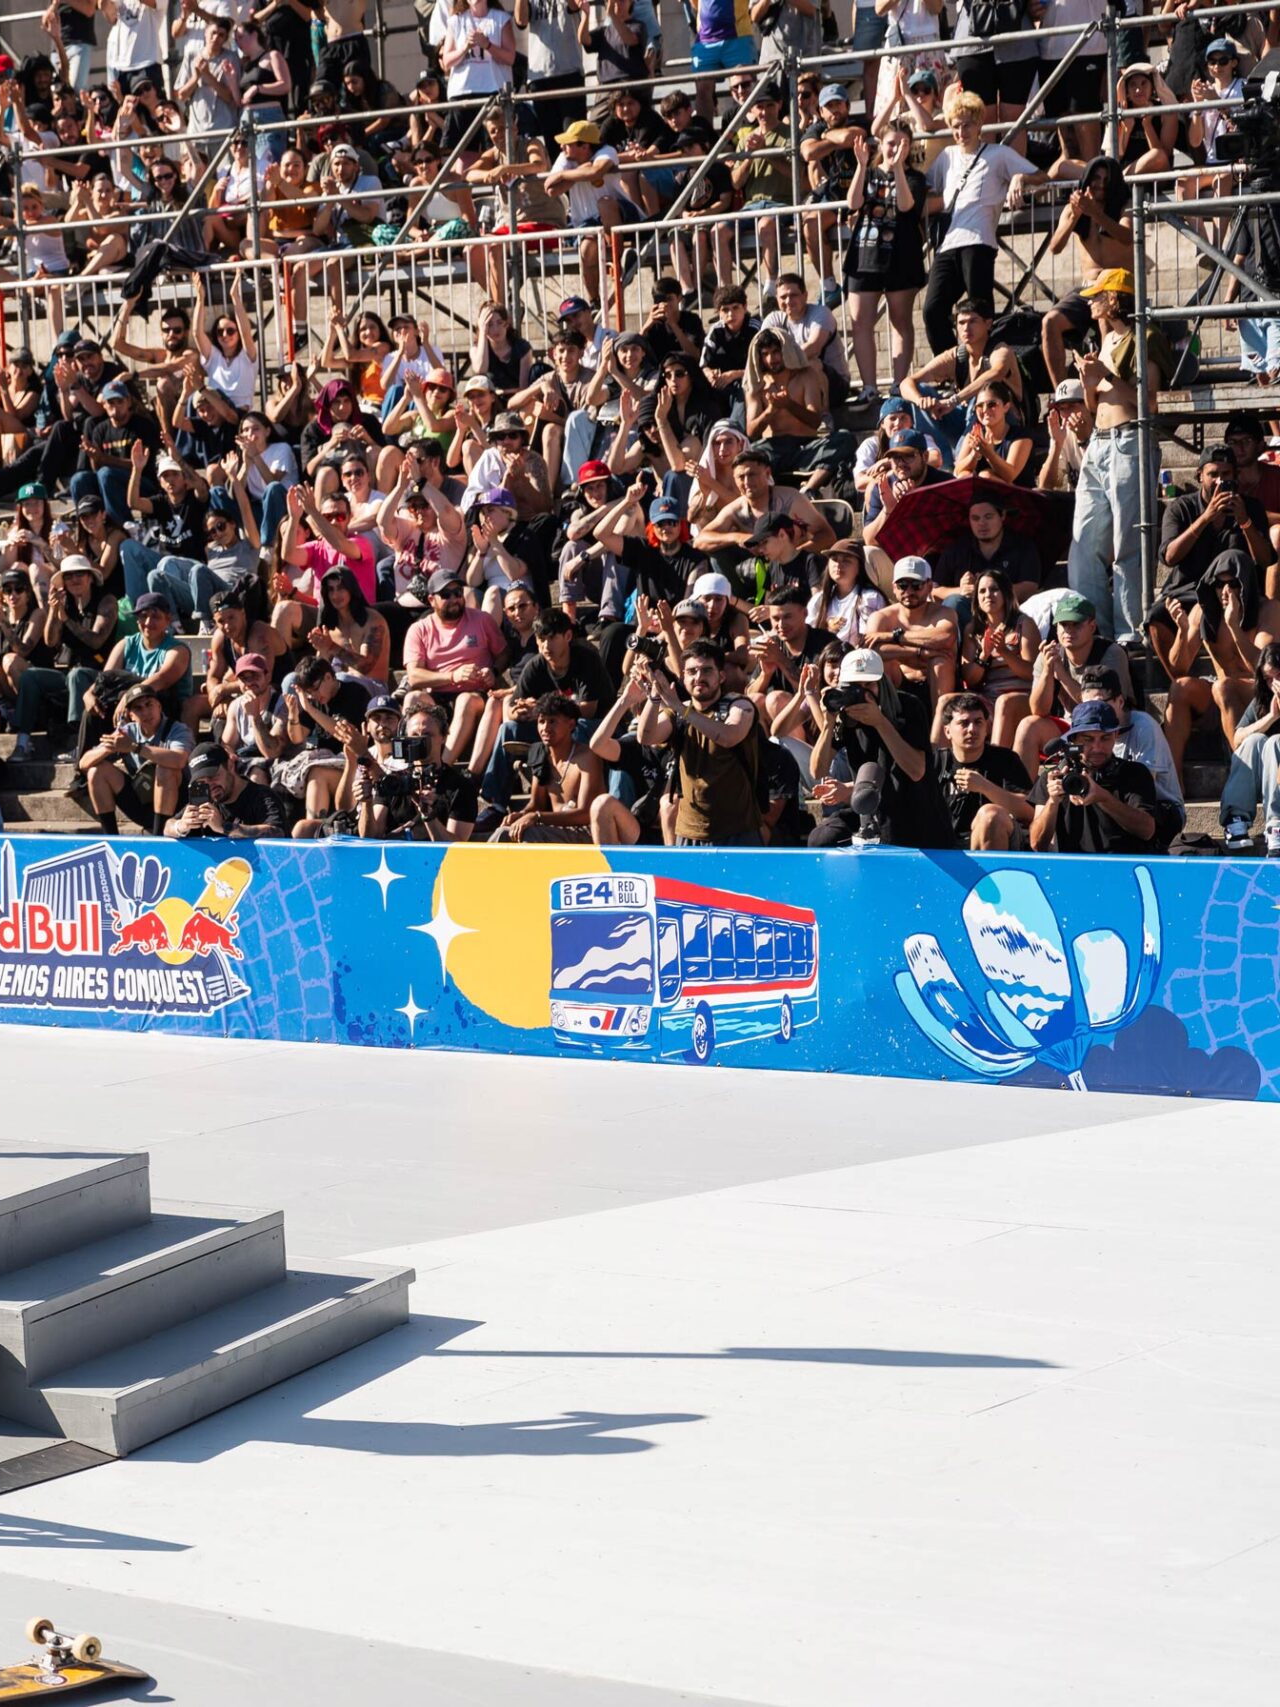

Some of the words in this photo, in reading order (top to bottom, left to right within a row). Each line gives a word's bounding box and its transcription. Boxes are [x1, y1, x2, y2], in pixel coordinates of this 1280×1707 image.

[575, 881, 613, 905] 24
[617, 881, 635, 892] RED
[618, 892, 640, 903] BULL
[27, 903, 100, 953] Bull
[52, 966, 109, 1000] AIRES
[113, 968, 210, 1005] CONQUEST
